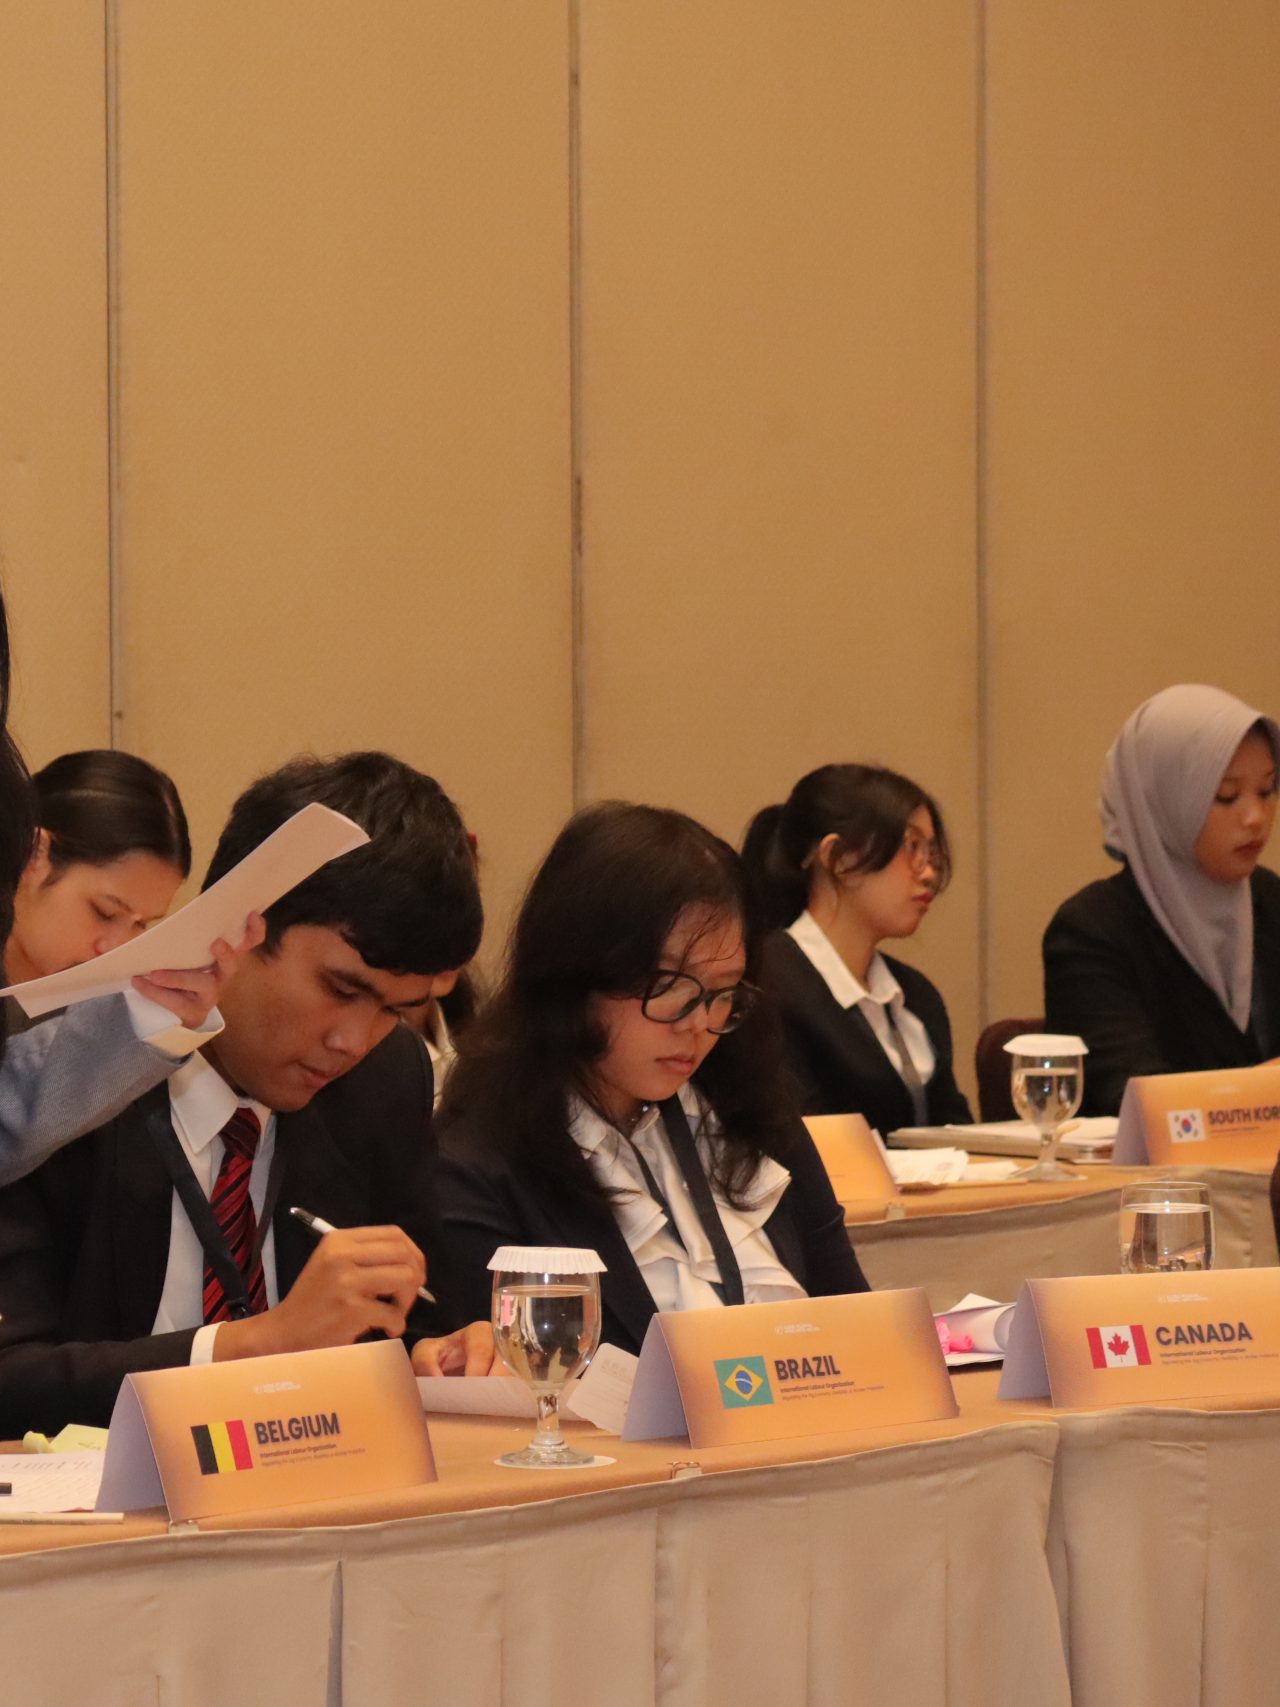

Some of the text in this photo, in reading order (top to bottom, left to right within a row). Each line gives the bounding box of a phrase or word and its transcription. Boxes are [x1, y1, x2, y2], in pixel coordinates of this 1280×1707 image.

[1207, 1108, 1252, 1125] SOUTH
[1155, 1321, 1253, 1346] CANADA
[774, 1355, 841, 1381] BRAZIL
[253, 1411, 341, 1445] BELGIUM
